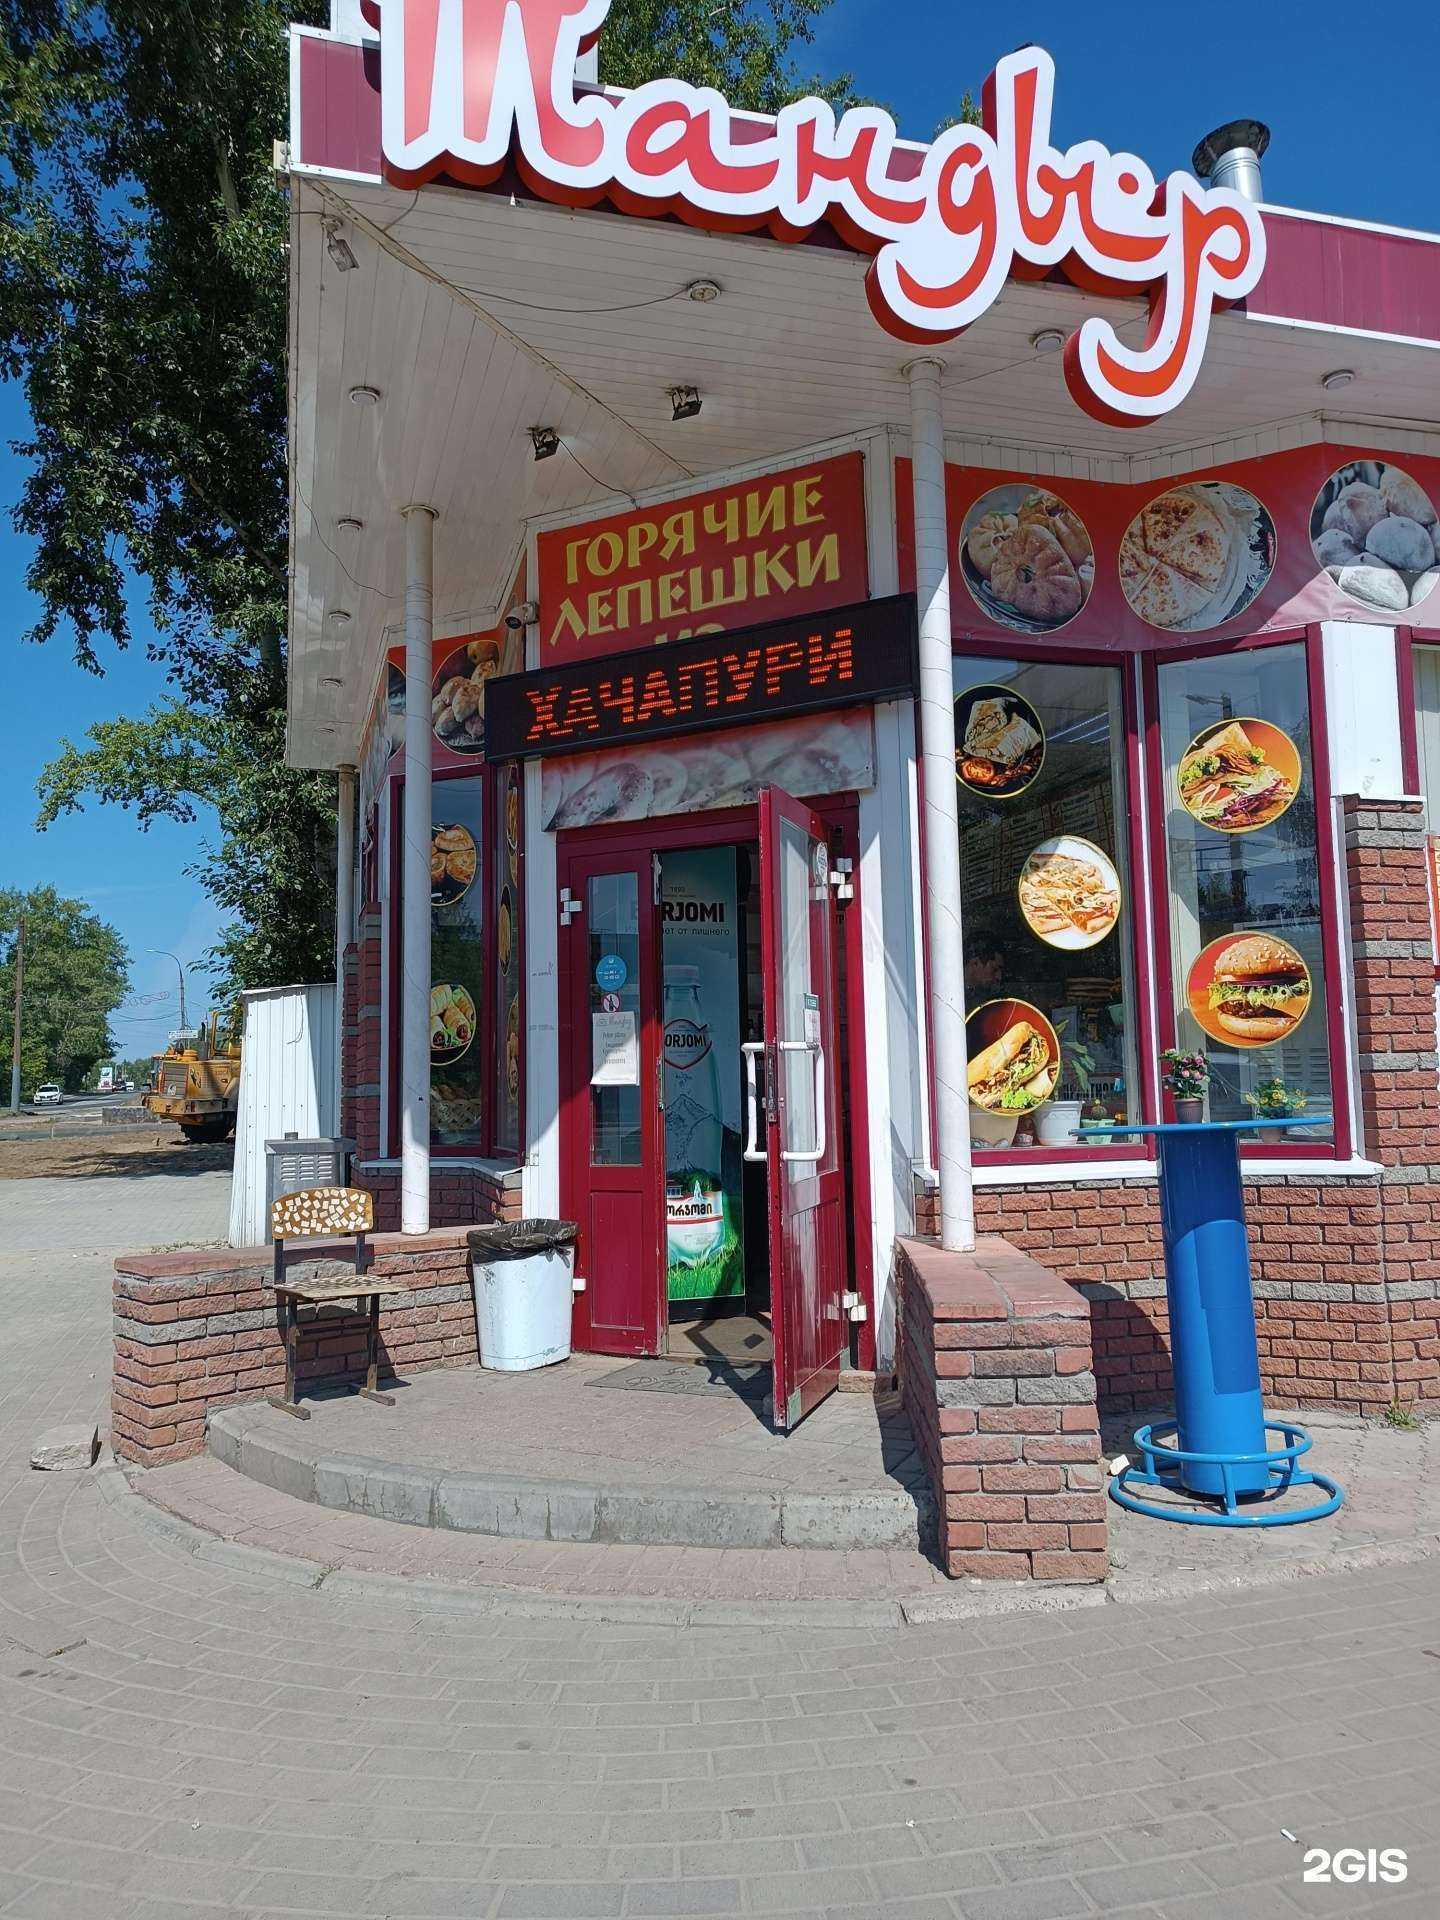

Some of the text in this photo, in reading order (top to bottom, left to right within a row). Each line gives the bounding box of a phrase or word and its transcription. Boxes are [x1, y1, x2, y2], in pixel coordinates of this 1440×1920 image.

[370, 0, 1266, 420] Тандыр
[566, 475, 825, 583] ГОРЯЧИЕ
[549, 533, 841, 646] ЛЕПЕШКИ
[526, 628, 854, 740] ХАЧАПУРИ
[661, 902, 725, 922] RJOMI
[665, 1034, 706, 1048] ORJOMI
[666, 1203, 713, 1216] ორჯომი
